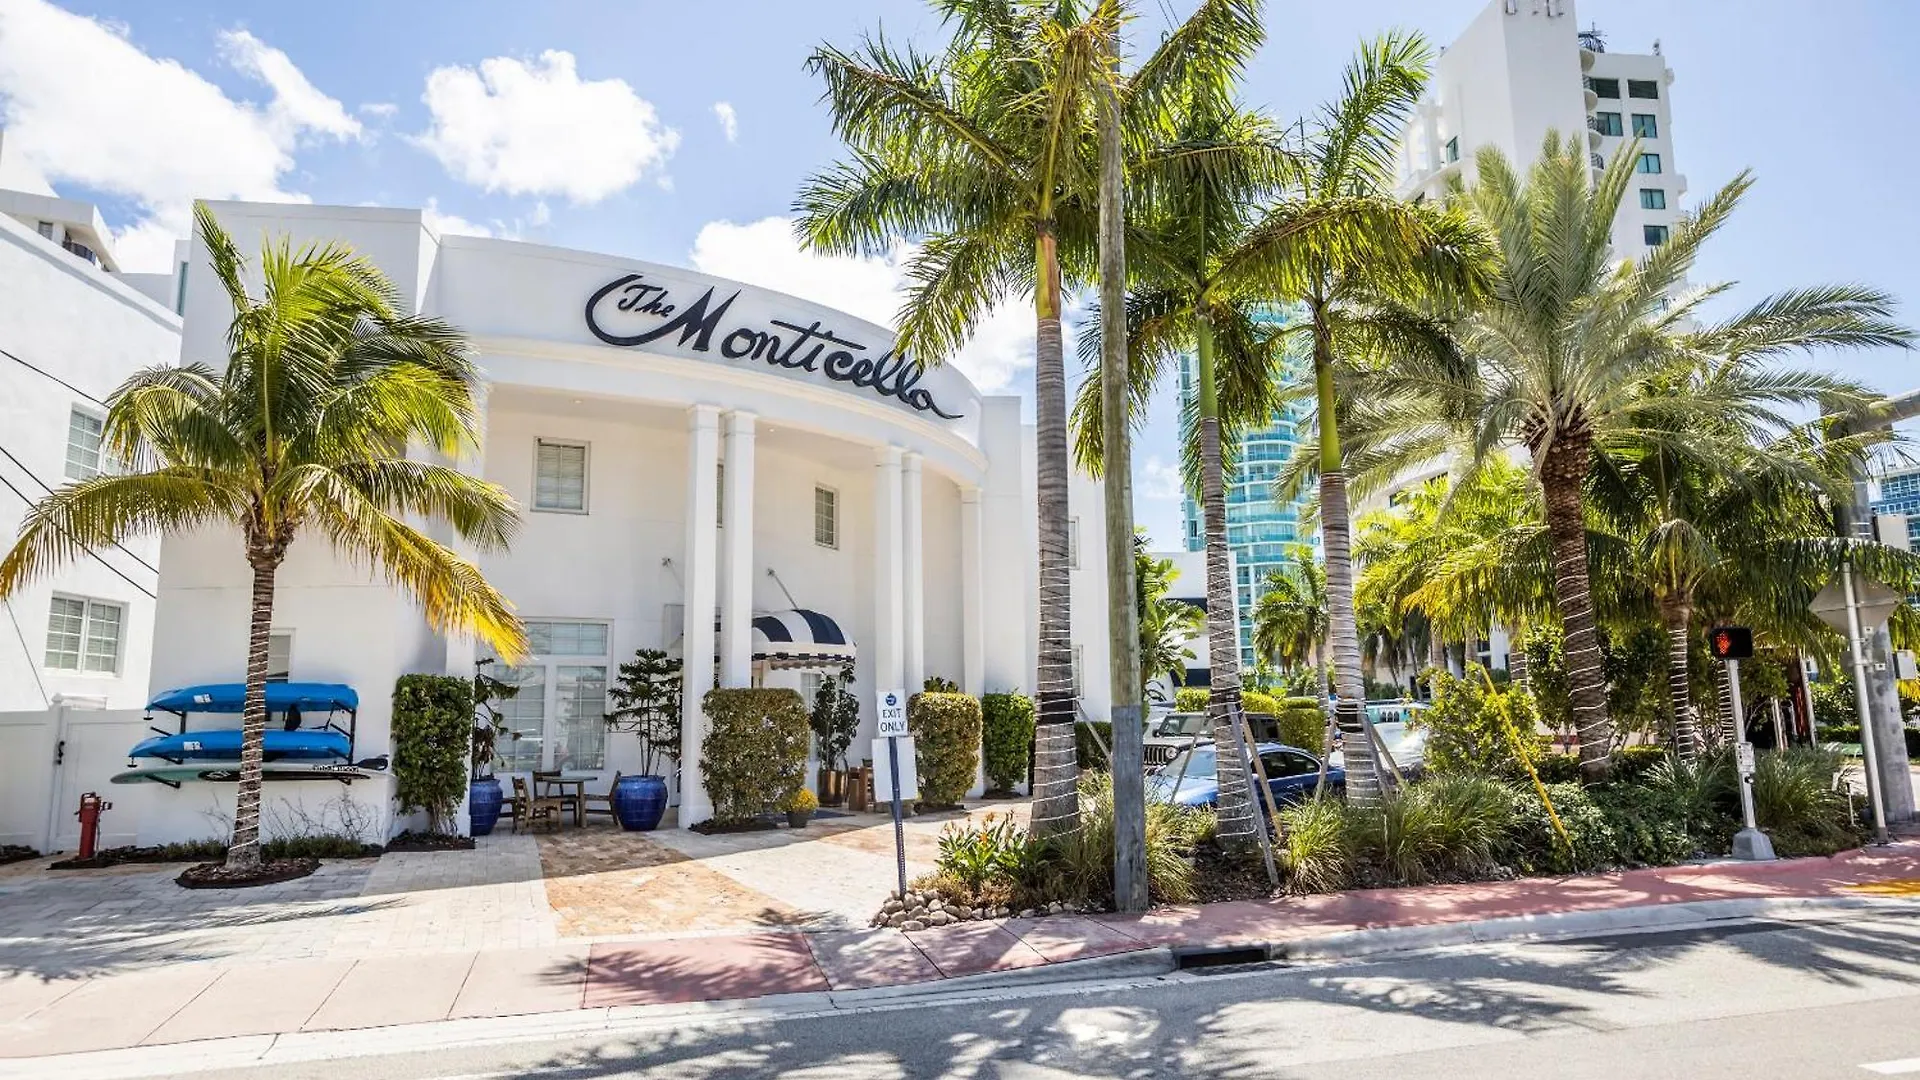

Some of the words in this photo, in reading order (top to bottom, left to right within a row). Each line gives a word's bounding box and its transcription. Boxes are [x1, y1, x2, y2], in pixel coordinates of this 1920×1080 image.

[617, 284, 675, 318] The
[585, 273, 965, 420] Monticello
[882, 708, 902, 719] EXIT
[880, 721, 906, 732] ONLY
